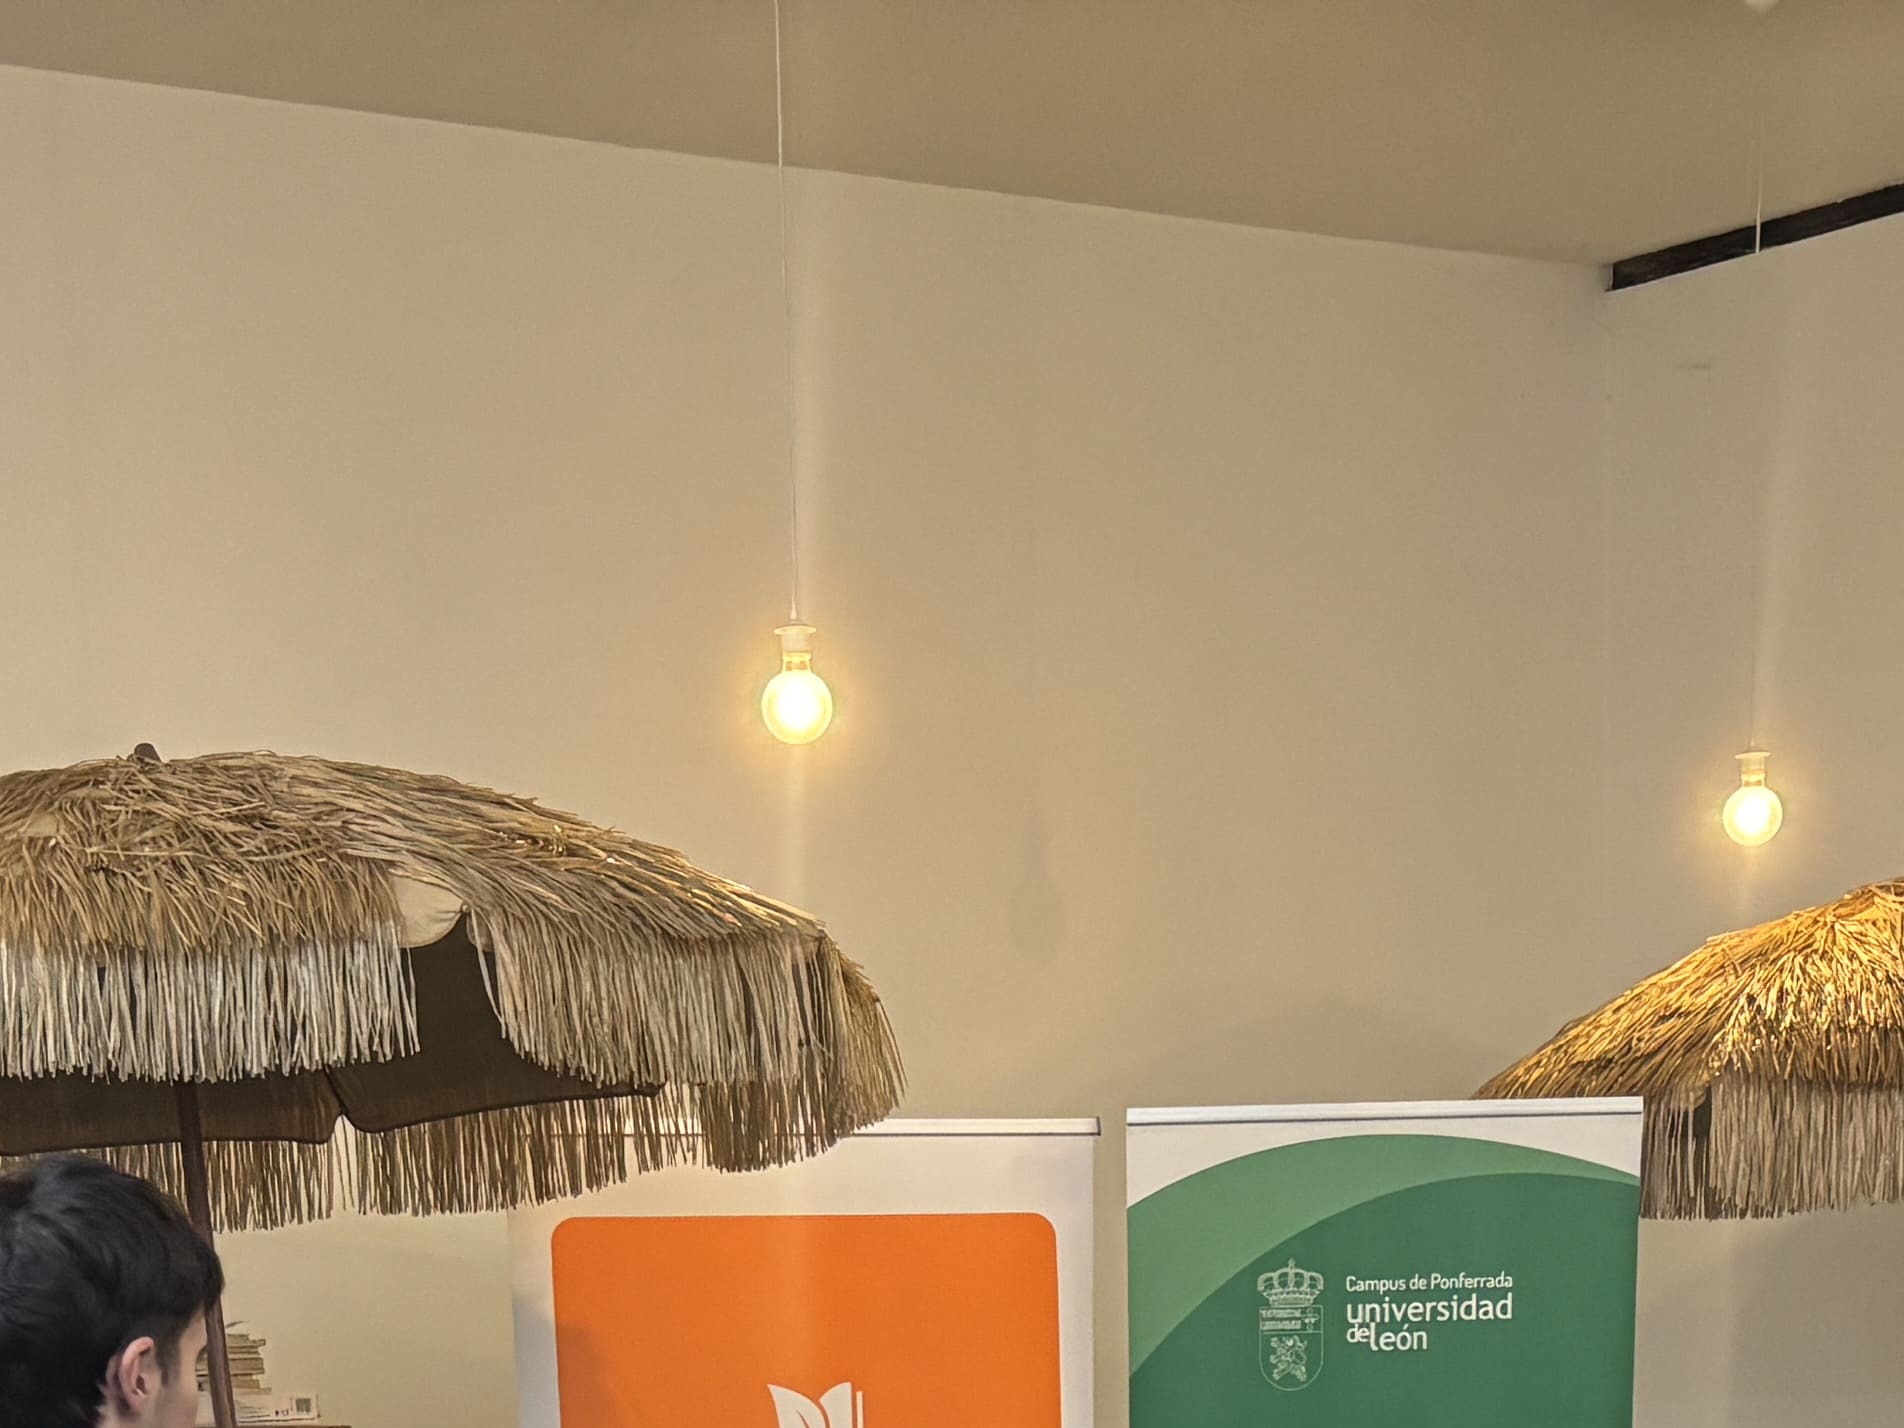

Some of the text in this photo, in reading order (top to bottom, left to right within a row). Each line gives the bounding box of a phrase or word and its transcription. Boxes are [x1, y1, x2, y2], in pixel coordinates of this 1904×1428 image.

[1346, 1270, 1513, 1294] Campus de Ponferrada
[1346, 1292, 1512, 1324] universidad
[1346, 1322, 1428, 1351] de león
